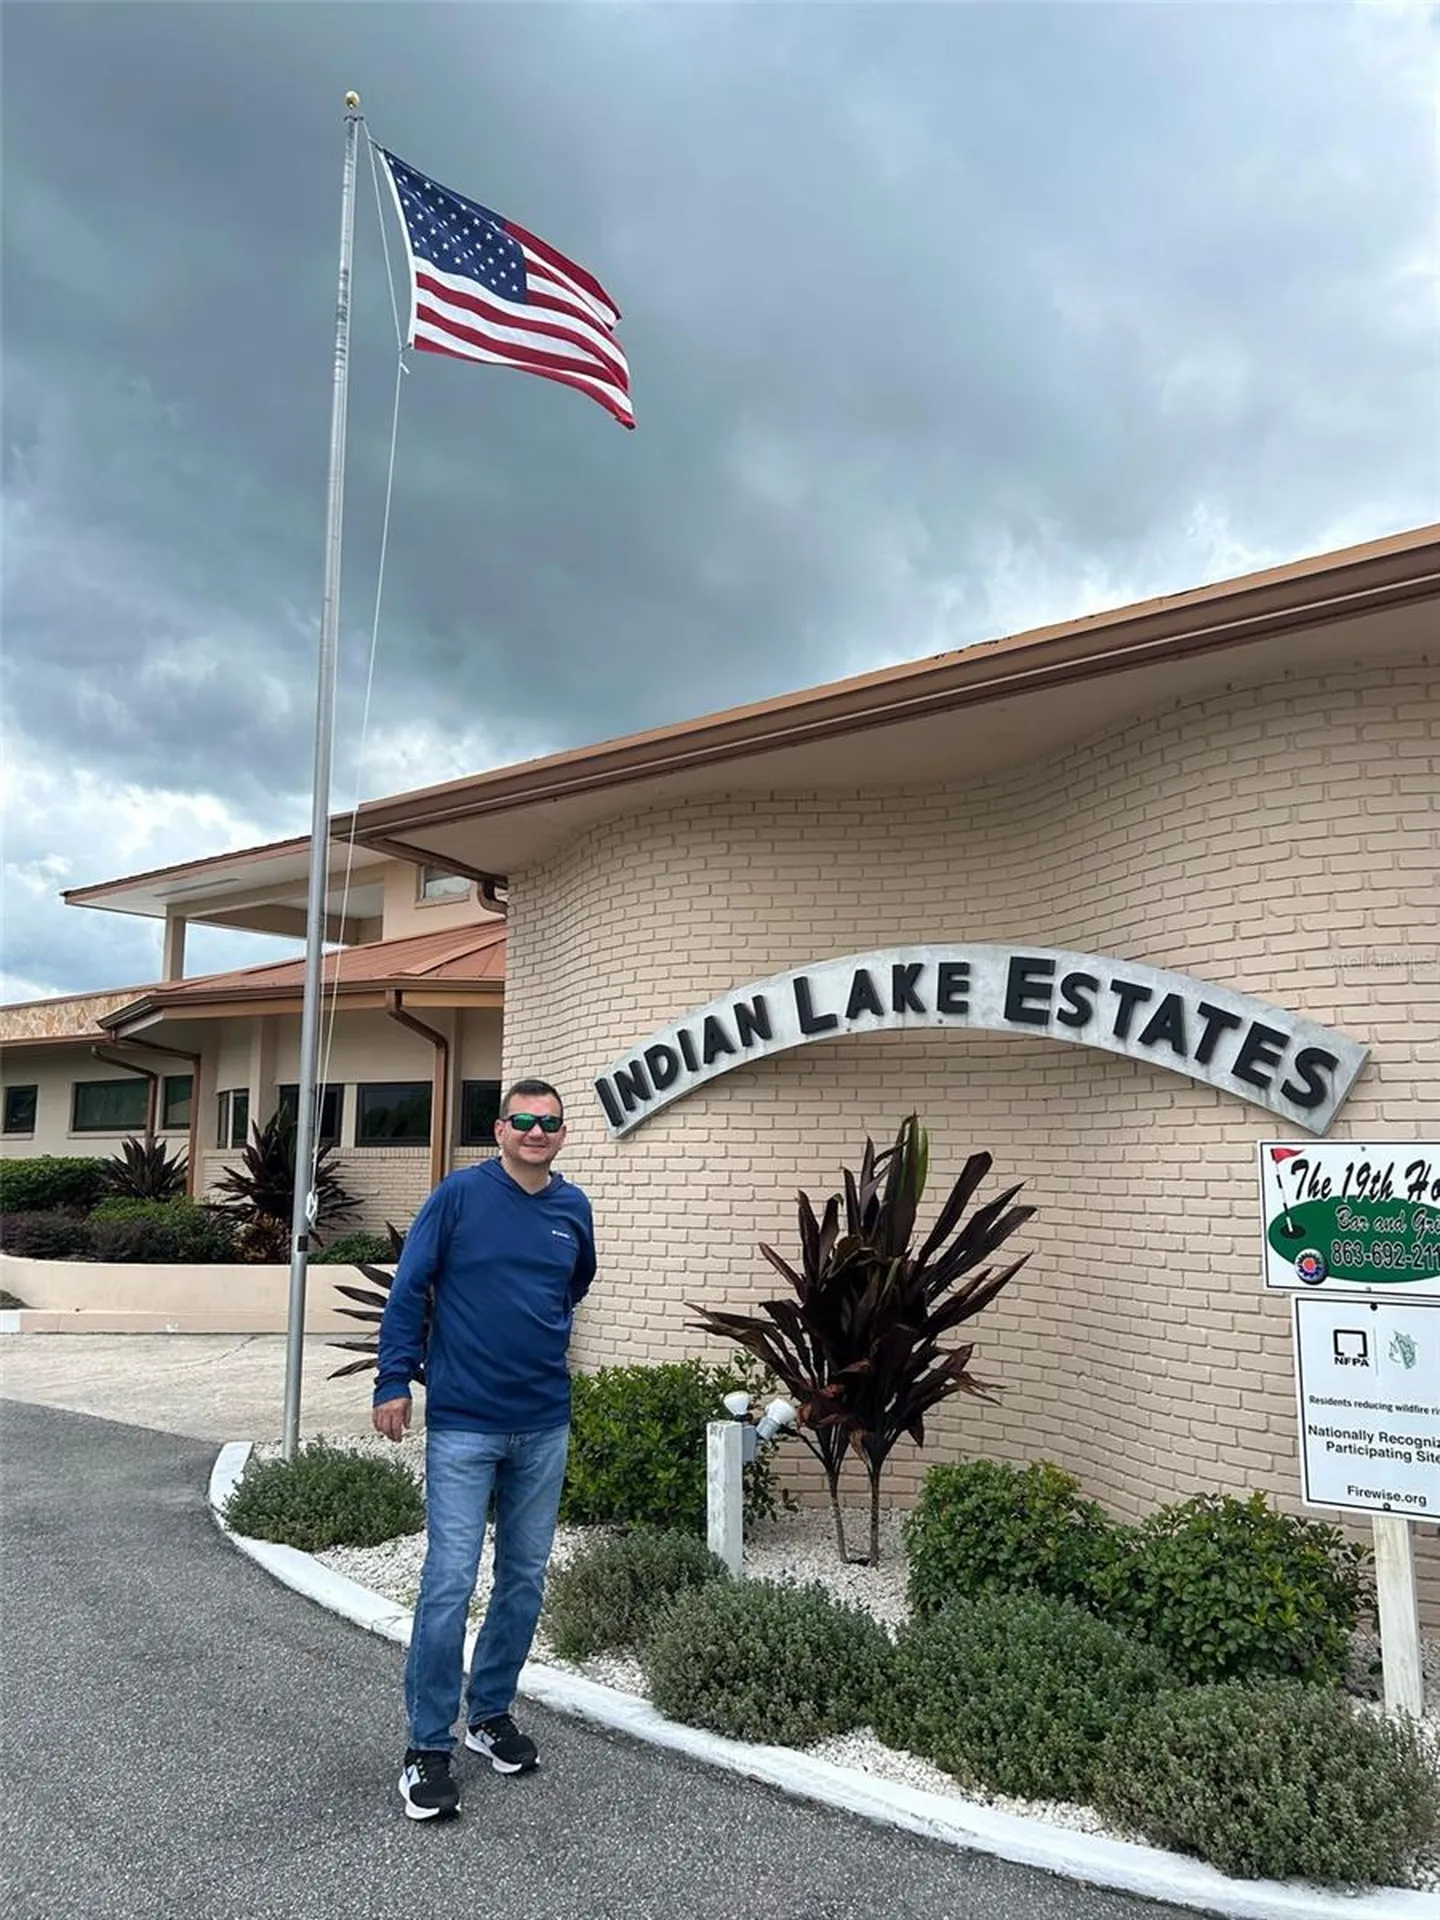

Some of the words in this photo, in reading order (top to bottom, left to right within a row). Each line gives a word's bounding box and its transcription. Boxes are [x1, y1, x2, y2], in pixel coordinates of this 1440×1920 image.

[595, 994, 773, 1127] INDIAN
[793, 962, 971, 1035] LAKE
[1004, 956, 1340, 1108] ESTATES
[1291, 1158, 1332, 1200] The
[1341, 1161, 1395, 1201] 19th
[1336, 1205, 1369, 1232] Bar
[1373, 1210, 1405, 1233] and
[1334, 1356, 1370, 1367] NFPA
[1309, 1395, 1352, 1407] Residents
[1353, 1400, 1393, 1413] reducing
[1395, 1403, 1429, 1415] wildfire
[1308, 1424, 1374, 1443] Nationally
[1326, 1440, 1412, 1463] Participating
[1347, 1485, 1427, 1507] Firewise.org
